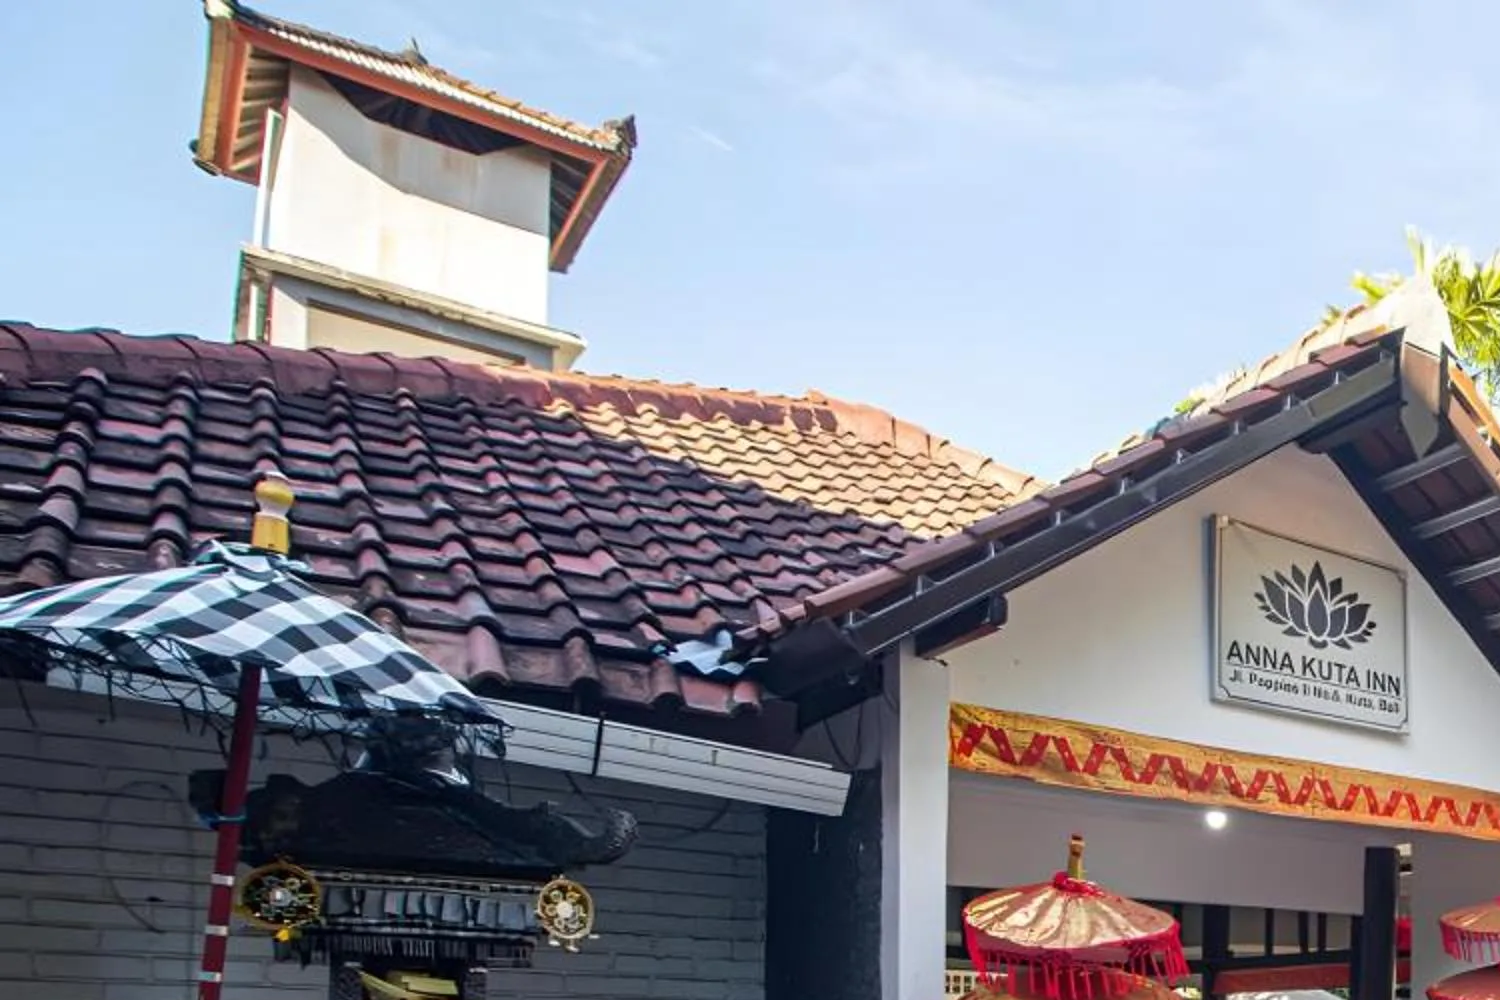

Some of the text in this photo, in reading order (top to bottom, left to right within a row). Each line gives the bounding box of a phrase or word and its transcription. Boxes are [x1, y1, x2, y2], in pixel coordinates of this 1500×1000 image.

[1227, 639, 1401, 696] ANNA KUTA INN
